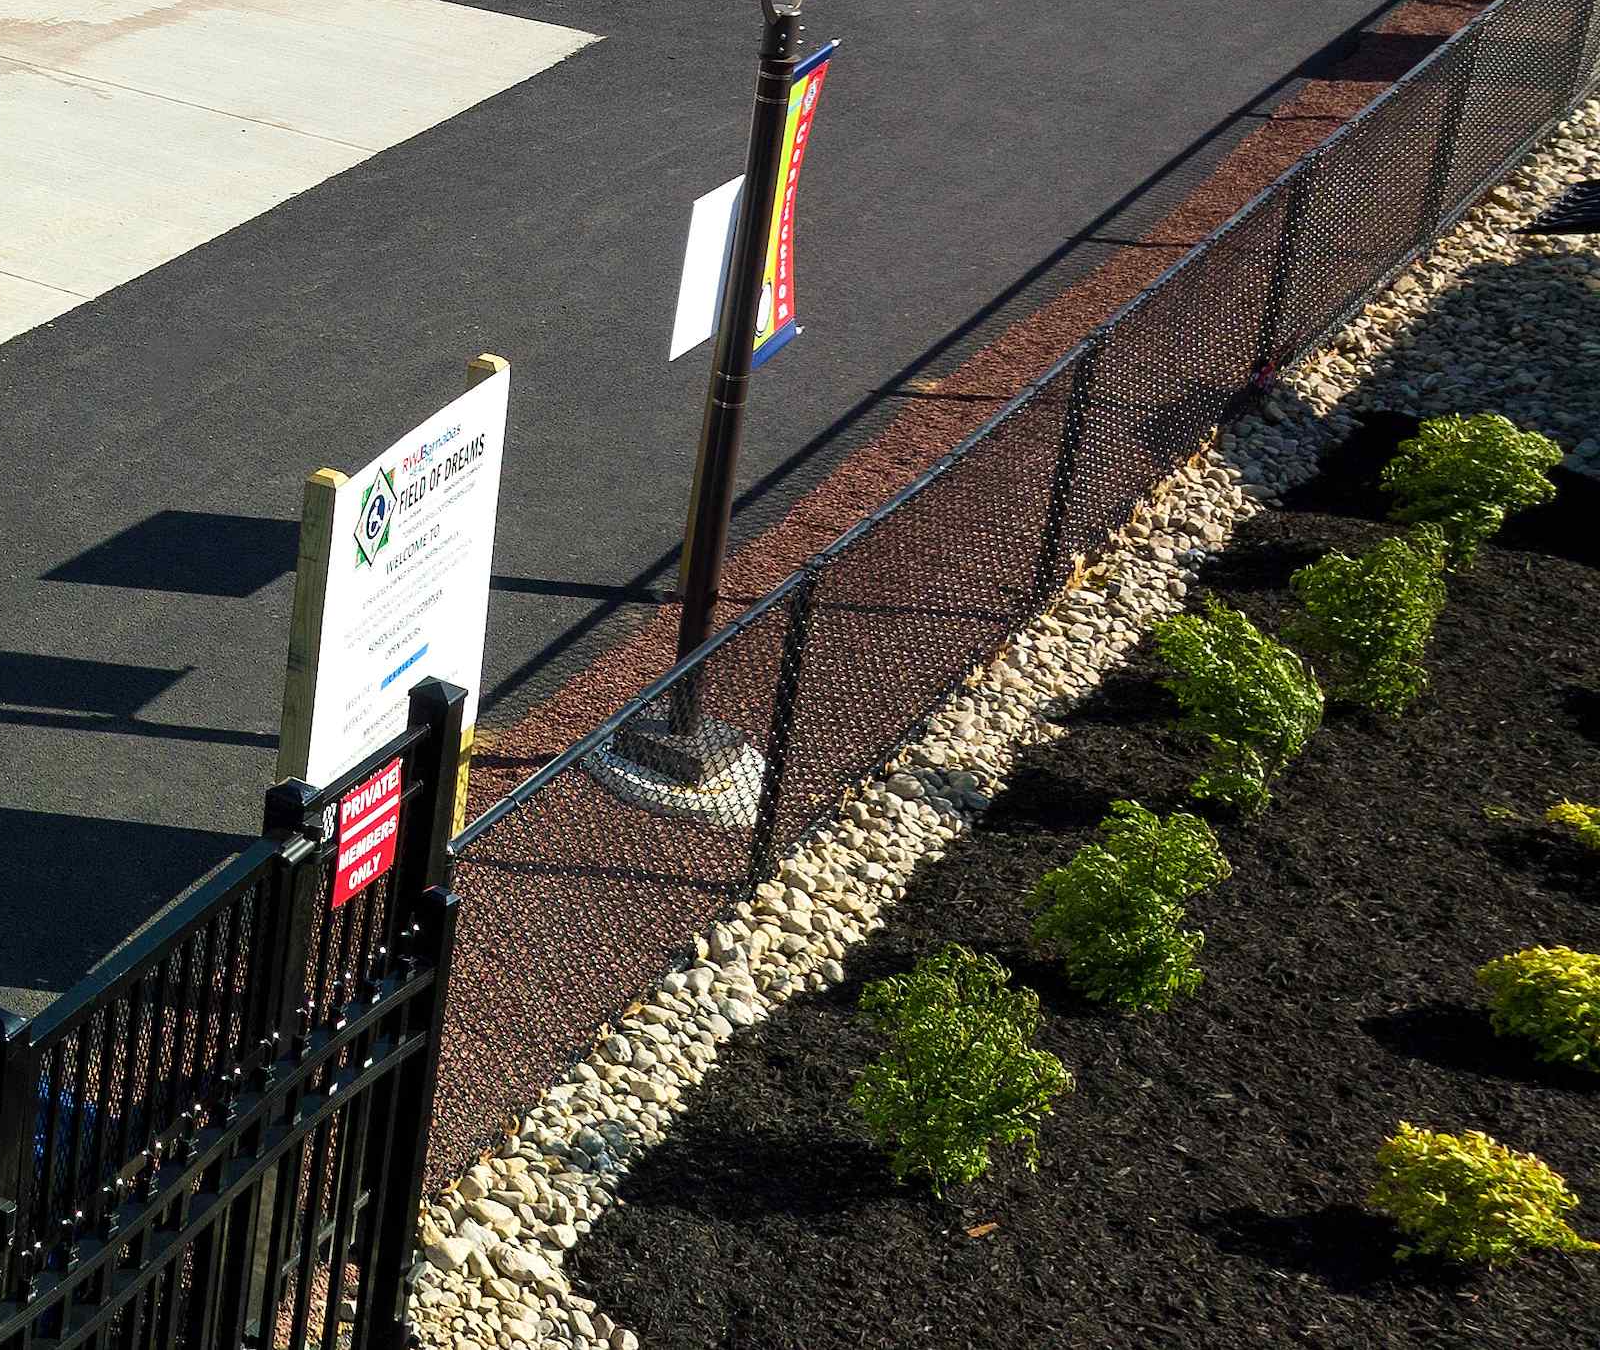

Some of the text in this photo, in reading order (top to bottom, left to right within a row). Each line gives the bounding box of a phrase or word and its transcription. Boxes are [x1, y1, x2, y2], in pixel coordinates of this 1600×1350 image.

[399, 476, 426, 514] FIELD
[430, 463, 443, 492] OF
[444, 433, 485, 481] DREAMS
[386, 532, 428, 575] WELCOME
[430, 524, 441, 541] TO
[339, 815, 397, 872] MEMBERS
[348, 854, 381, 890] ONLY
